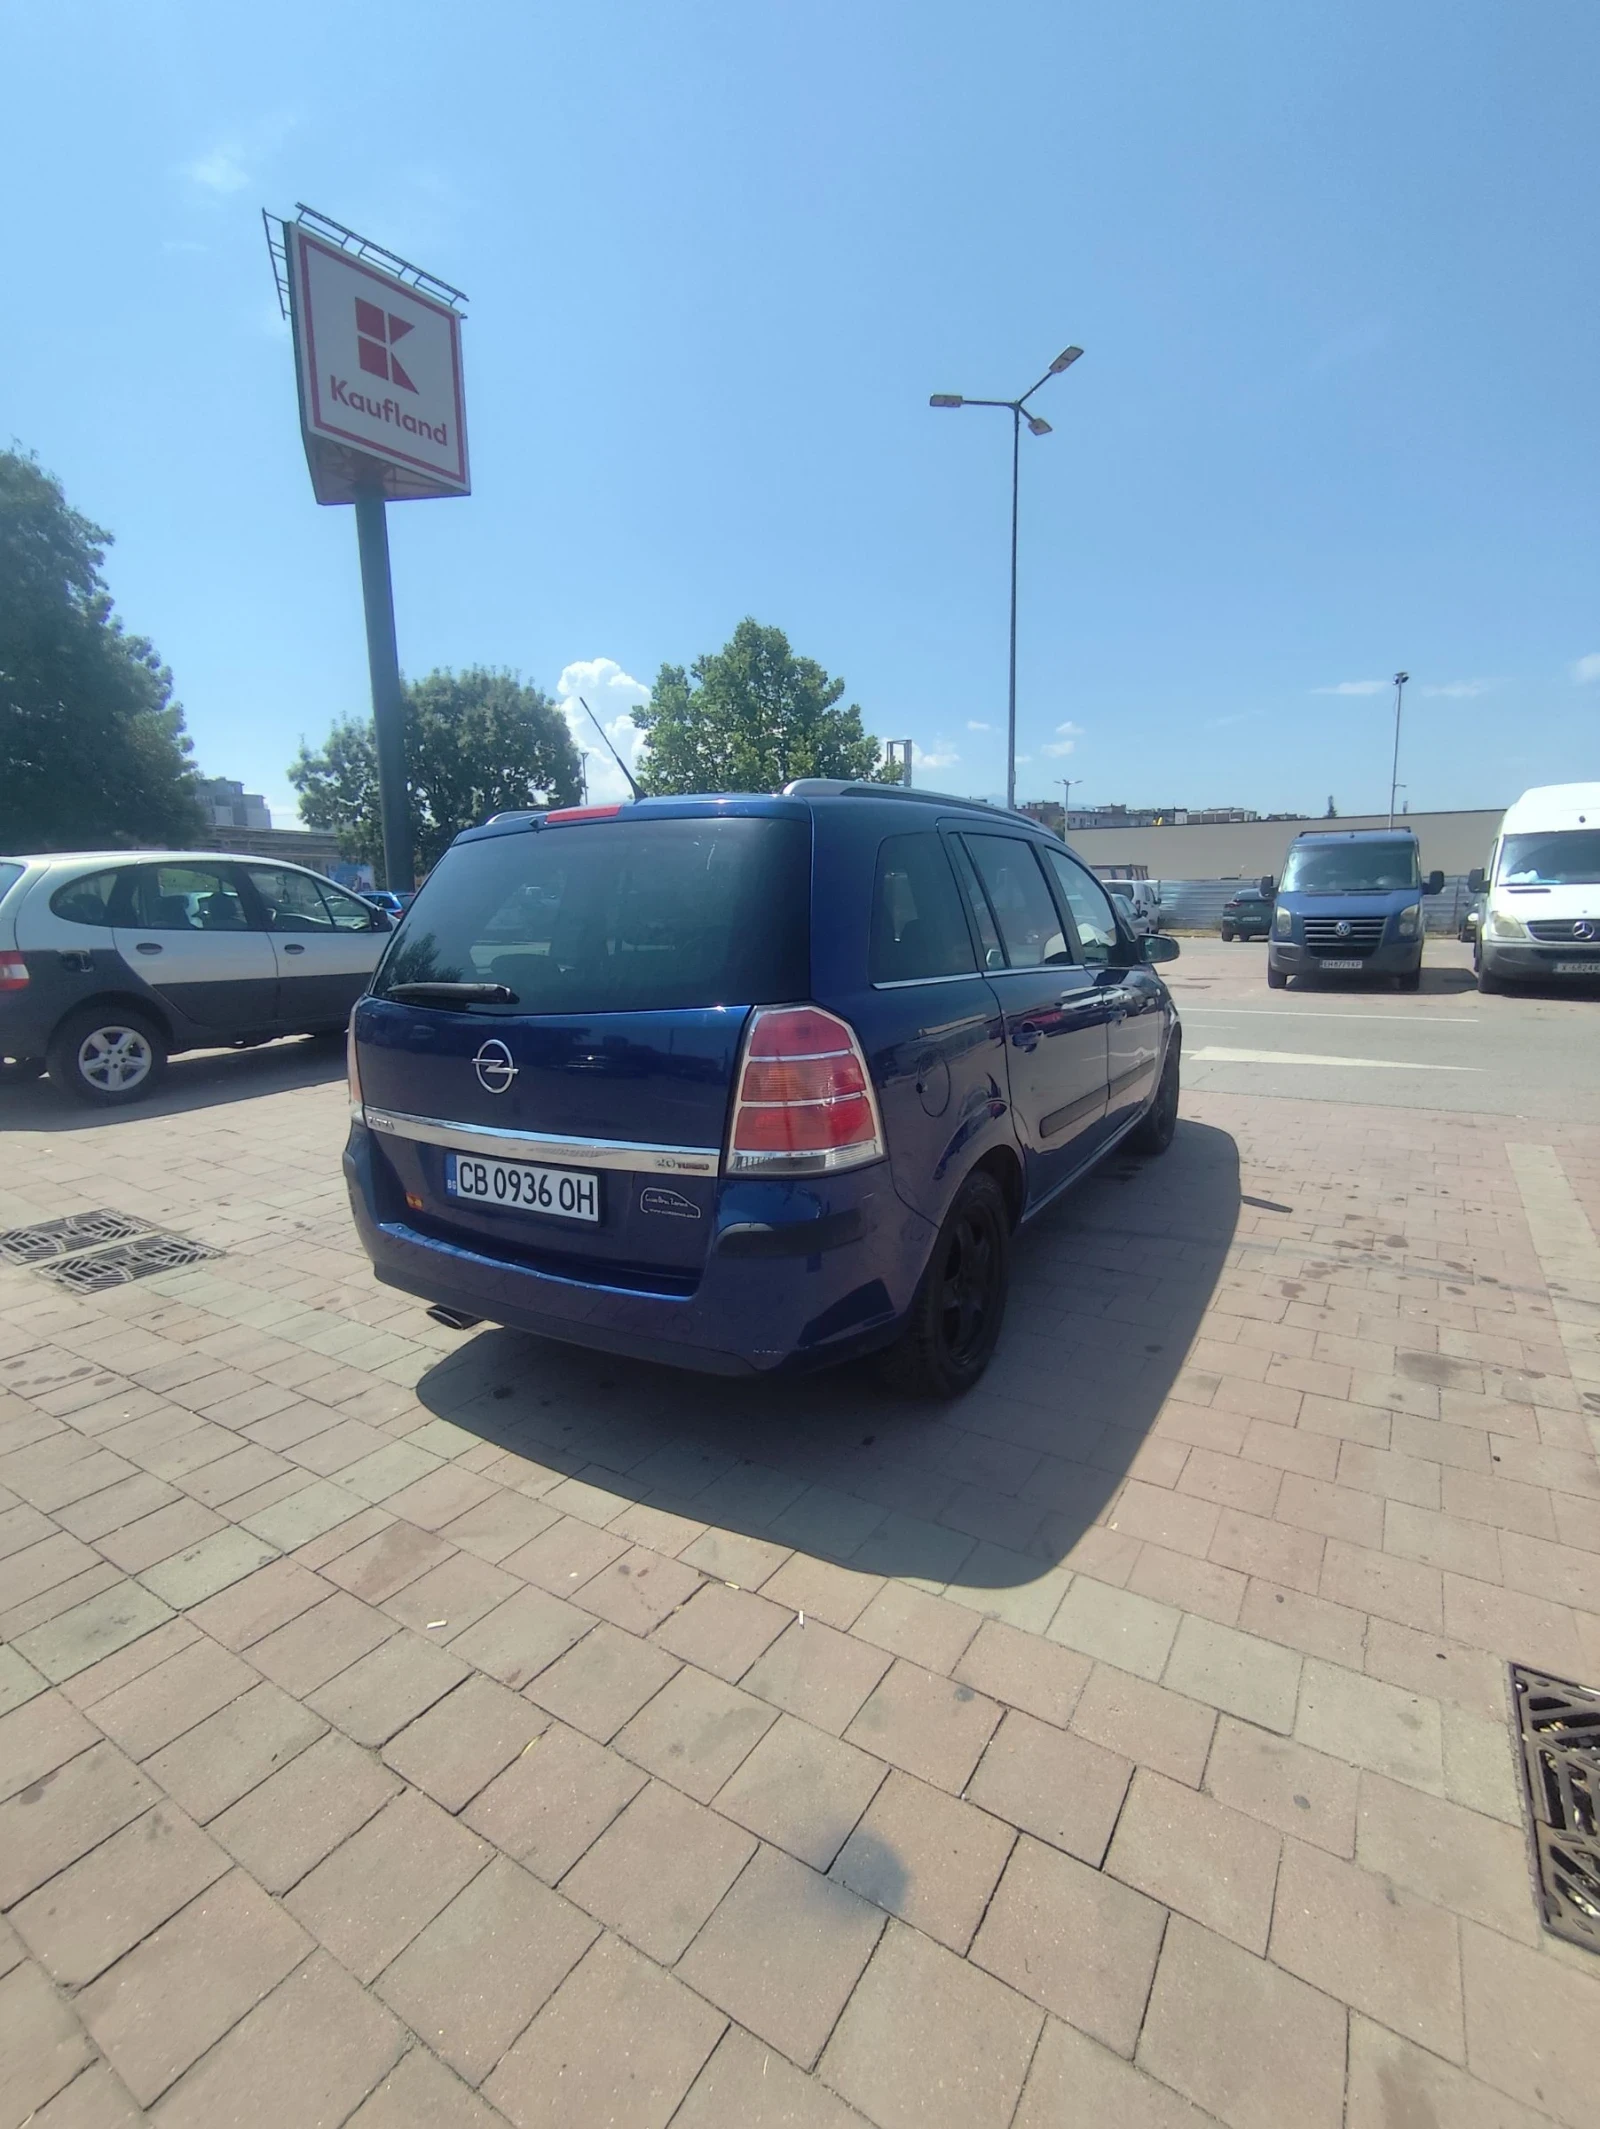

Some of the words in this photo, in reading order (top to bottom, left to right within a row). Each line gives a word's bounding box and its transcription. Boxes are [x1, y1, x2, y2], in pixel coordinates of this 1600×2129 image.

[329, 374, 448, 447] Kaufland
[447, 1179, 457, 1190] BG
[459, 1161, 488, 1196] CB
[493, 1167, 553, 1208] 0936
[558, 1177, 594, 1215] OH
